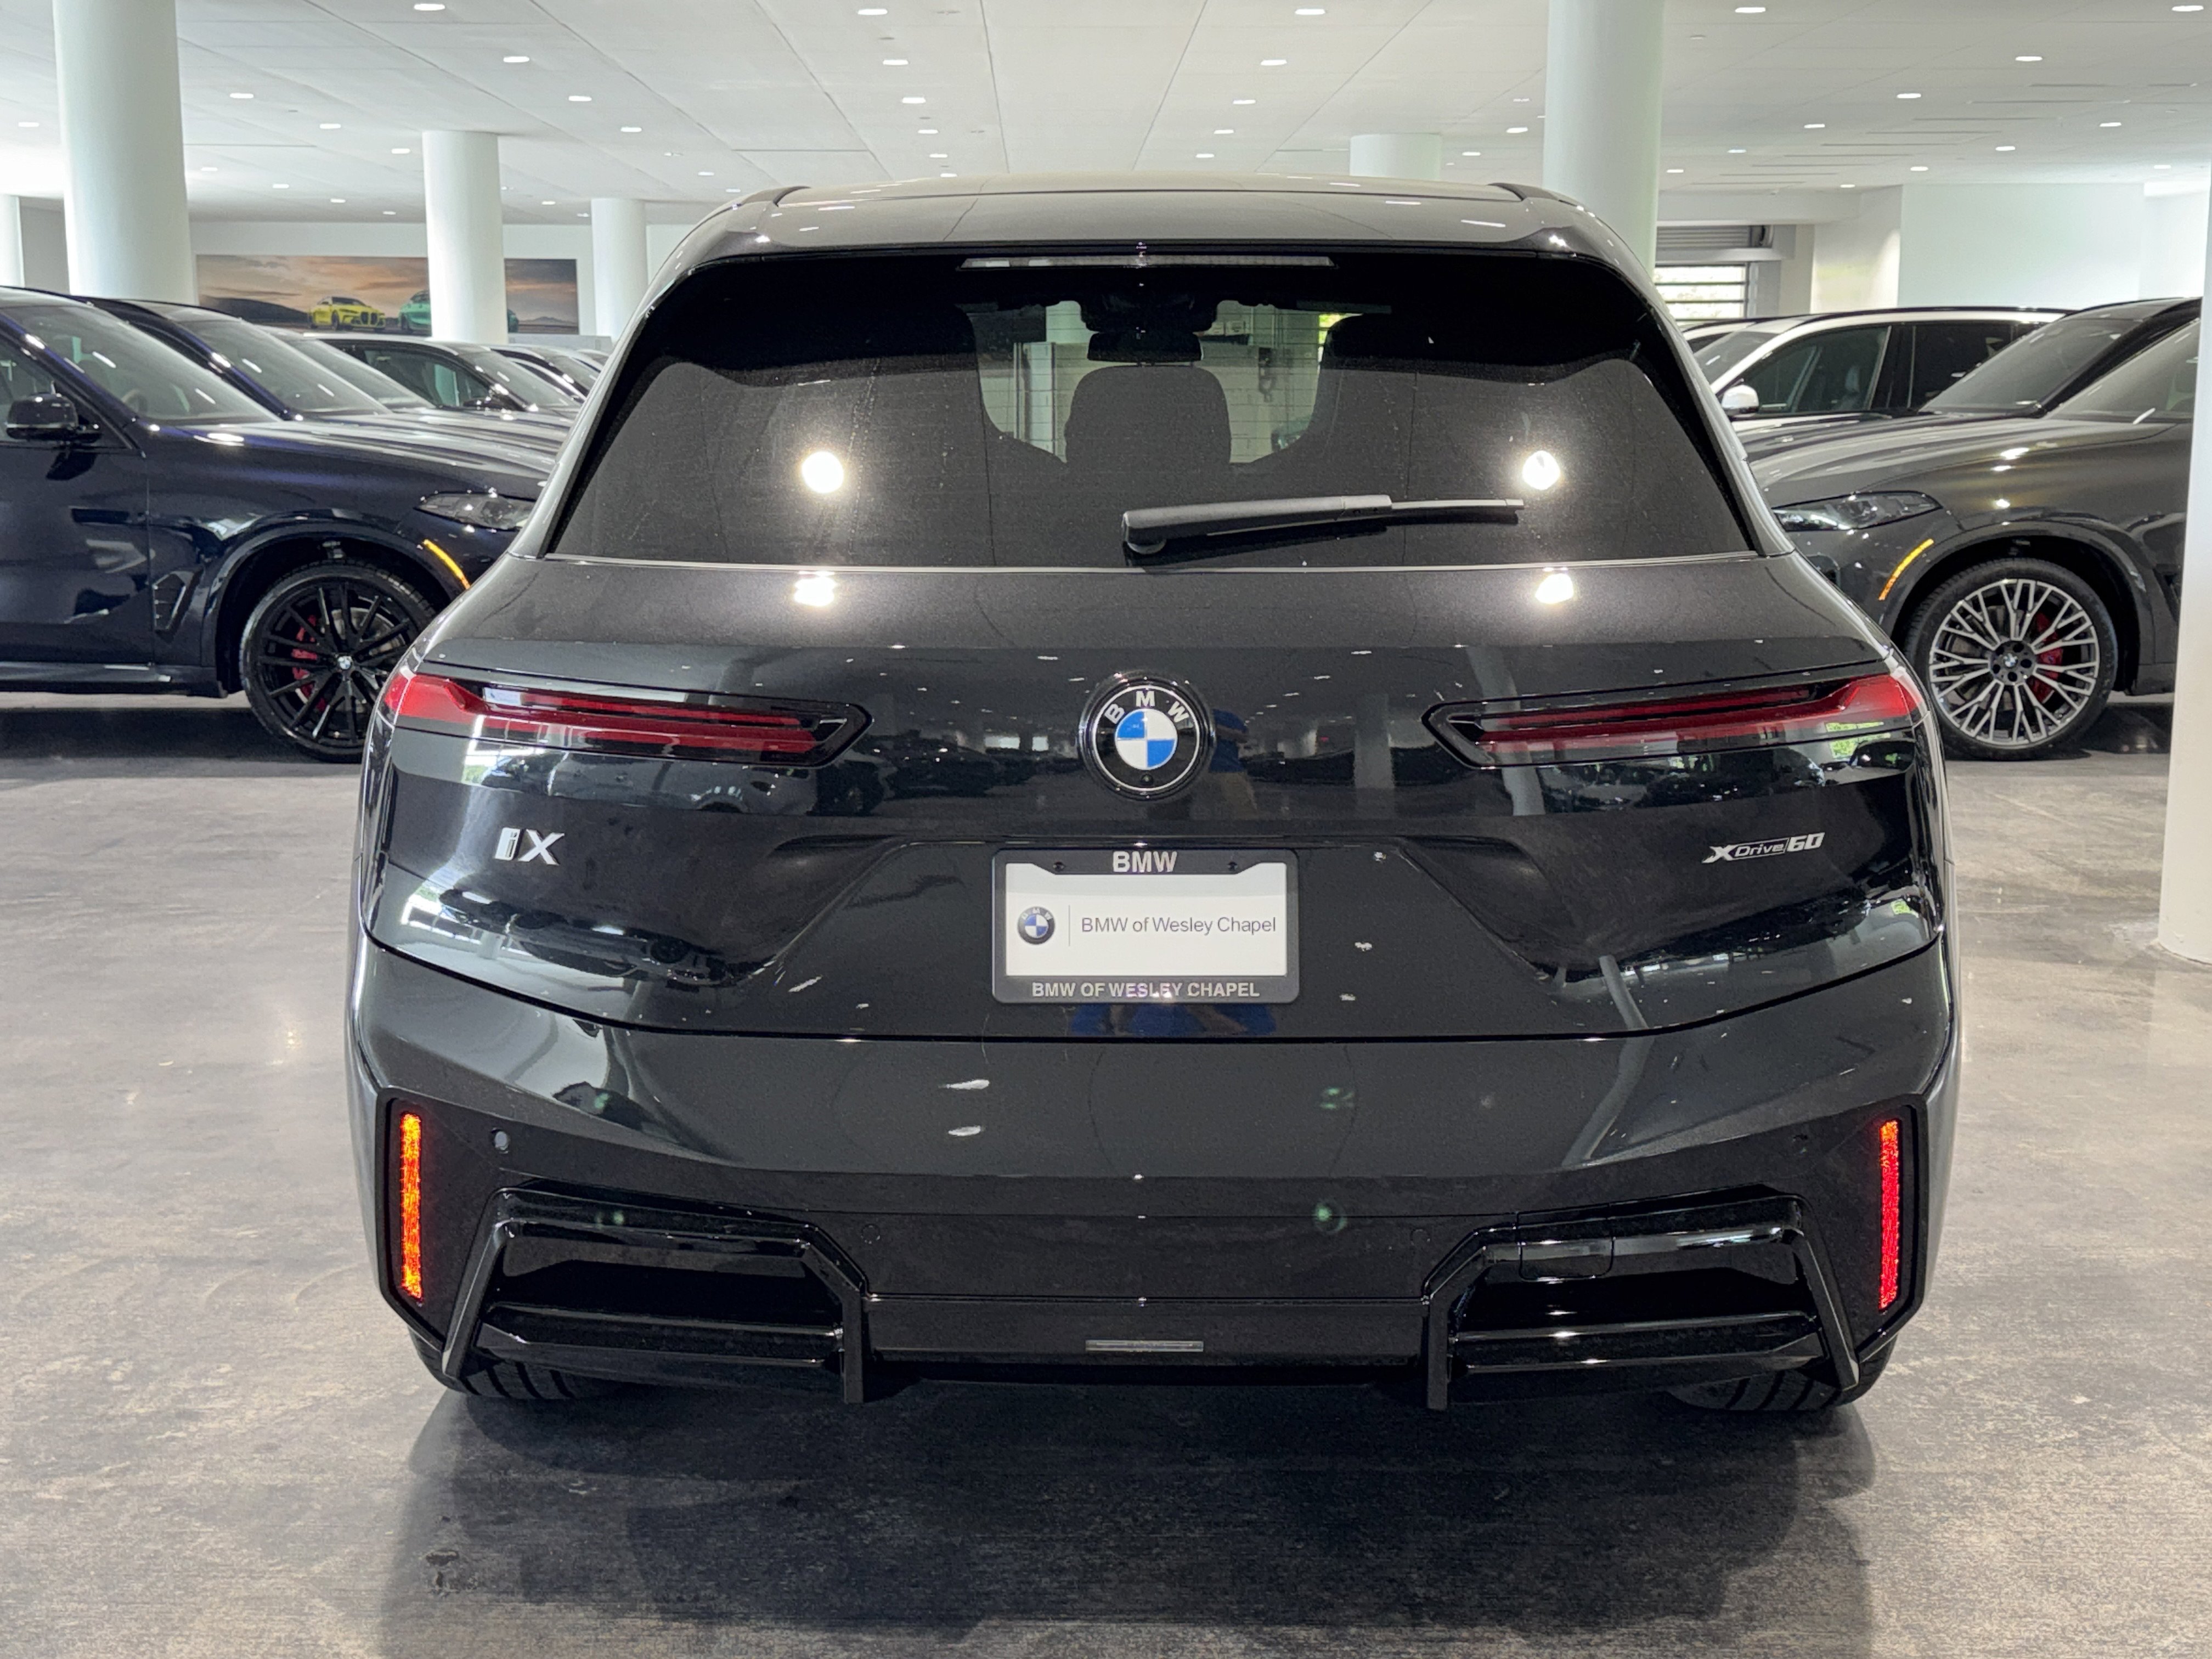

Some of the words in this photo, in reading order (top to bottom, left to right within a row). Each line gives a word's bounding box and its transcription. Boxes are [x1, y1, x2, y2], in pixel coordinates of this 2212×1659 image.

[1104, 691, 1189, 724] BMW
[1112, 851, 1177, 872] BMW
[1082, 917, 1128, 932] BMW
[1132, 917, 1149, 932] of
[1152, 917, 1213, 936] Wesley
[1217, 917, 1276, 935] Chapel
[1032, 982, 1076, 997] BMW
[1081, 982, 1105, 997] OF
[1108, 983, 1182, 997] WESLEY
[1187, 982, 1260, 997] CHAPEL
